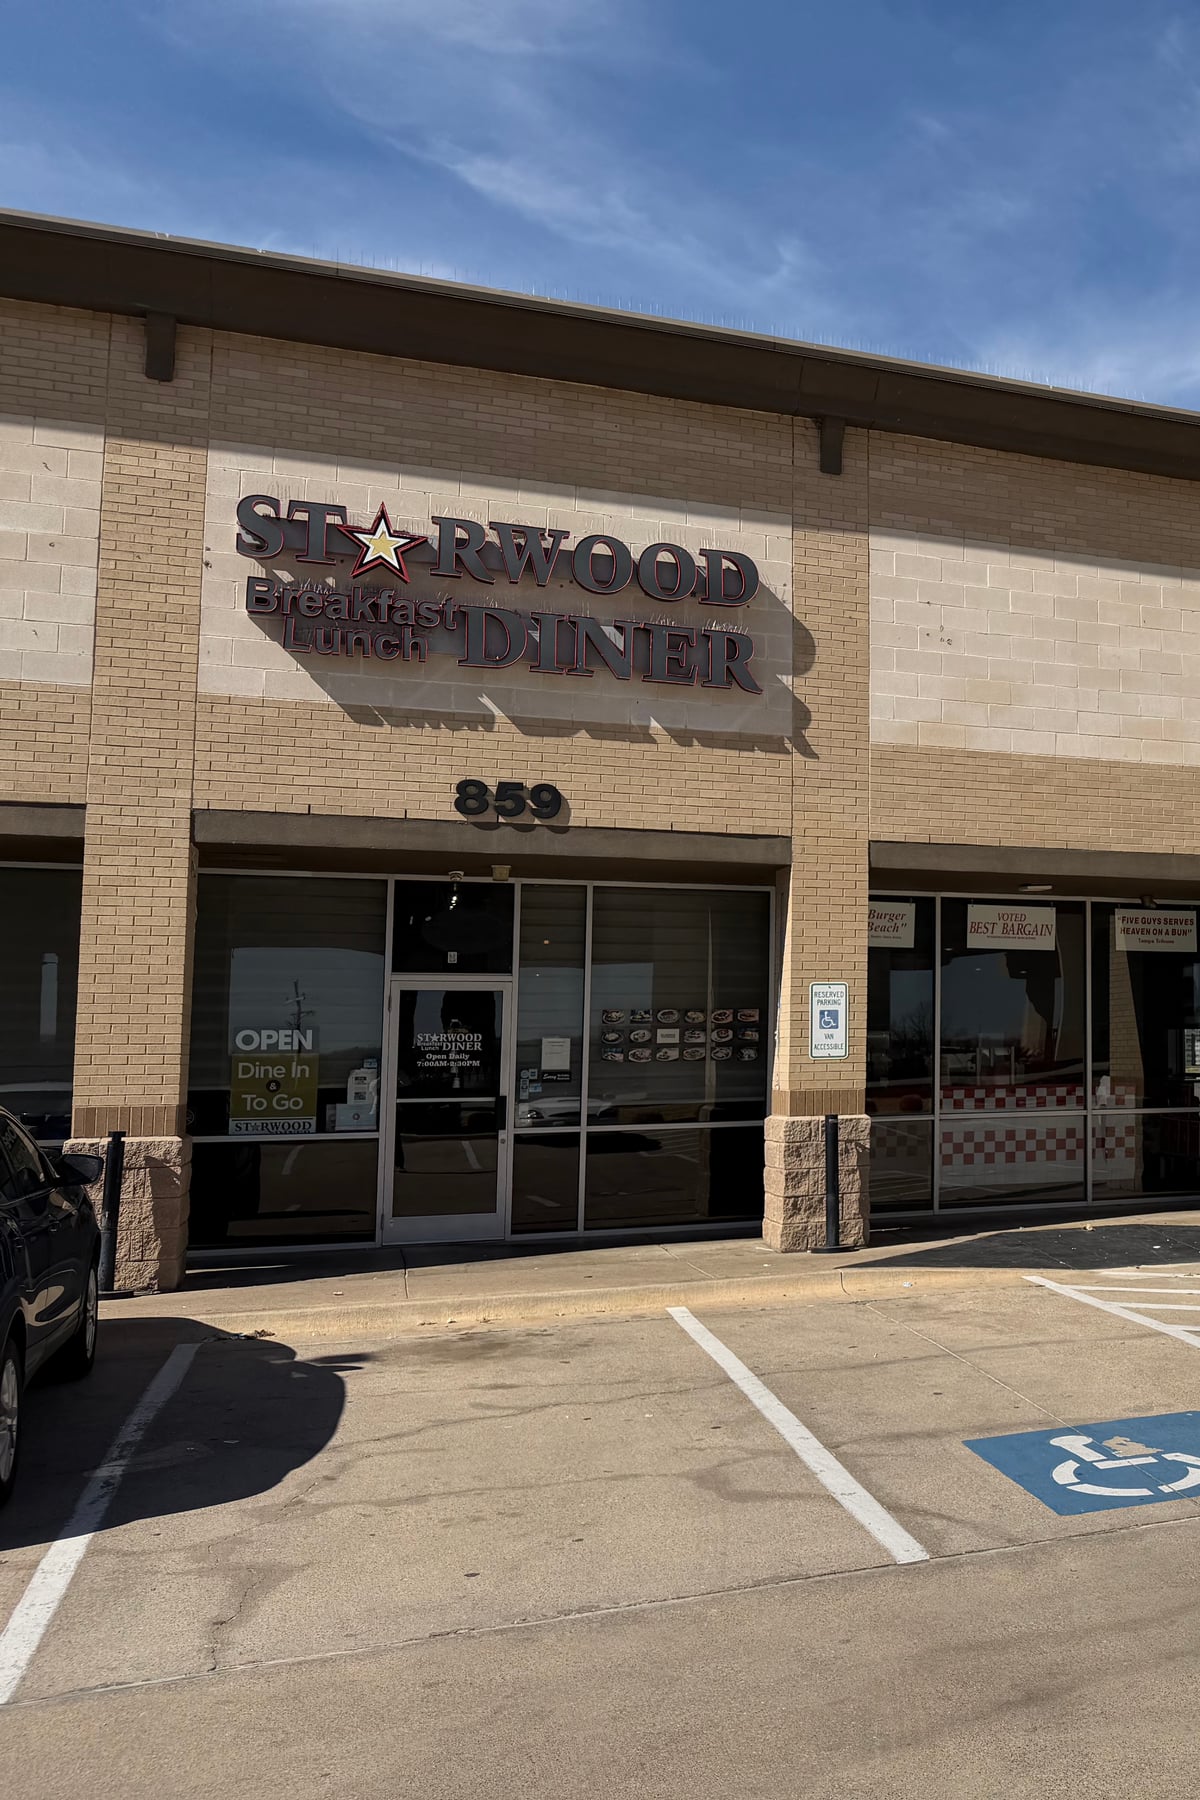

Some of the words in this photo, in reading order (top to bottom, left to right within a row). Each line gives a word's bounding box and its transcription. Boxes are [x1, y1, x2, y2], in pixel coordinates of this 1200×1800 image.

[246, 576, 461, 630] Breakfast
[283, 616, 428, 662] Lunch
[457, 604, 764, 695] DINER
[454, 779, 563, 820] 859
[868, 909, 906, 922] Burger
[997, 912, 1027, 922] VOTED
[1140, 917, 1161, 925] GUYS
[1163, 917, 1194, 926] SERVES
[969, 922, 998, 934] BEST
[1001, 922, 1053, 936] BARGAIN
[1120, 927, 1151, 935] HEAVEN
[1152, 928, 1163, 936] ON
[235, 1029, 313, 1051] OPEN
[442, 1042, 482, 1050] DINER
[238, 1062, 287, 1079] Dine
[291, 1061, 310, 1079] In
[268, 1082, 277, 1091] &
[241, 1094, 268, 1111] To
[272, 1094, 304, 1111] Go
